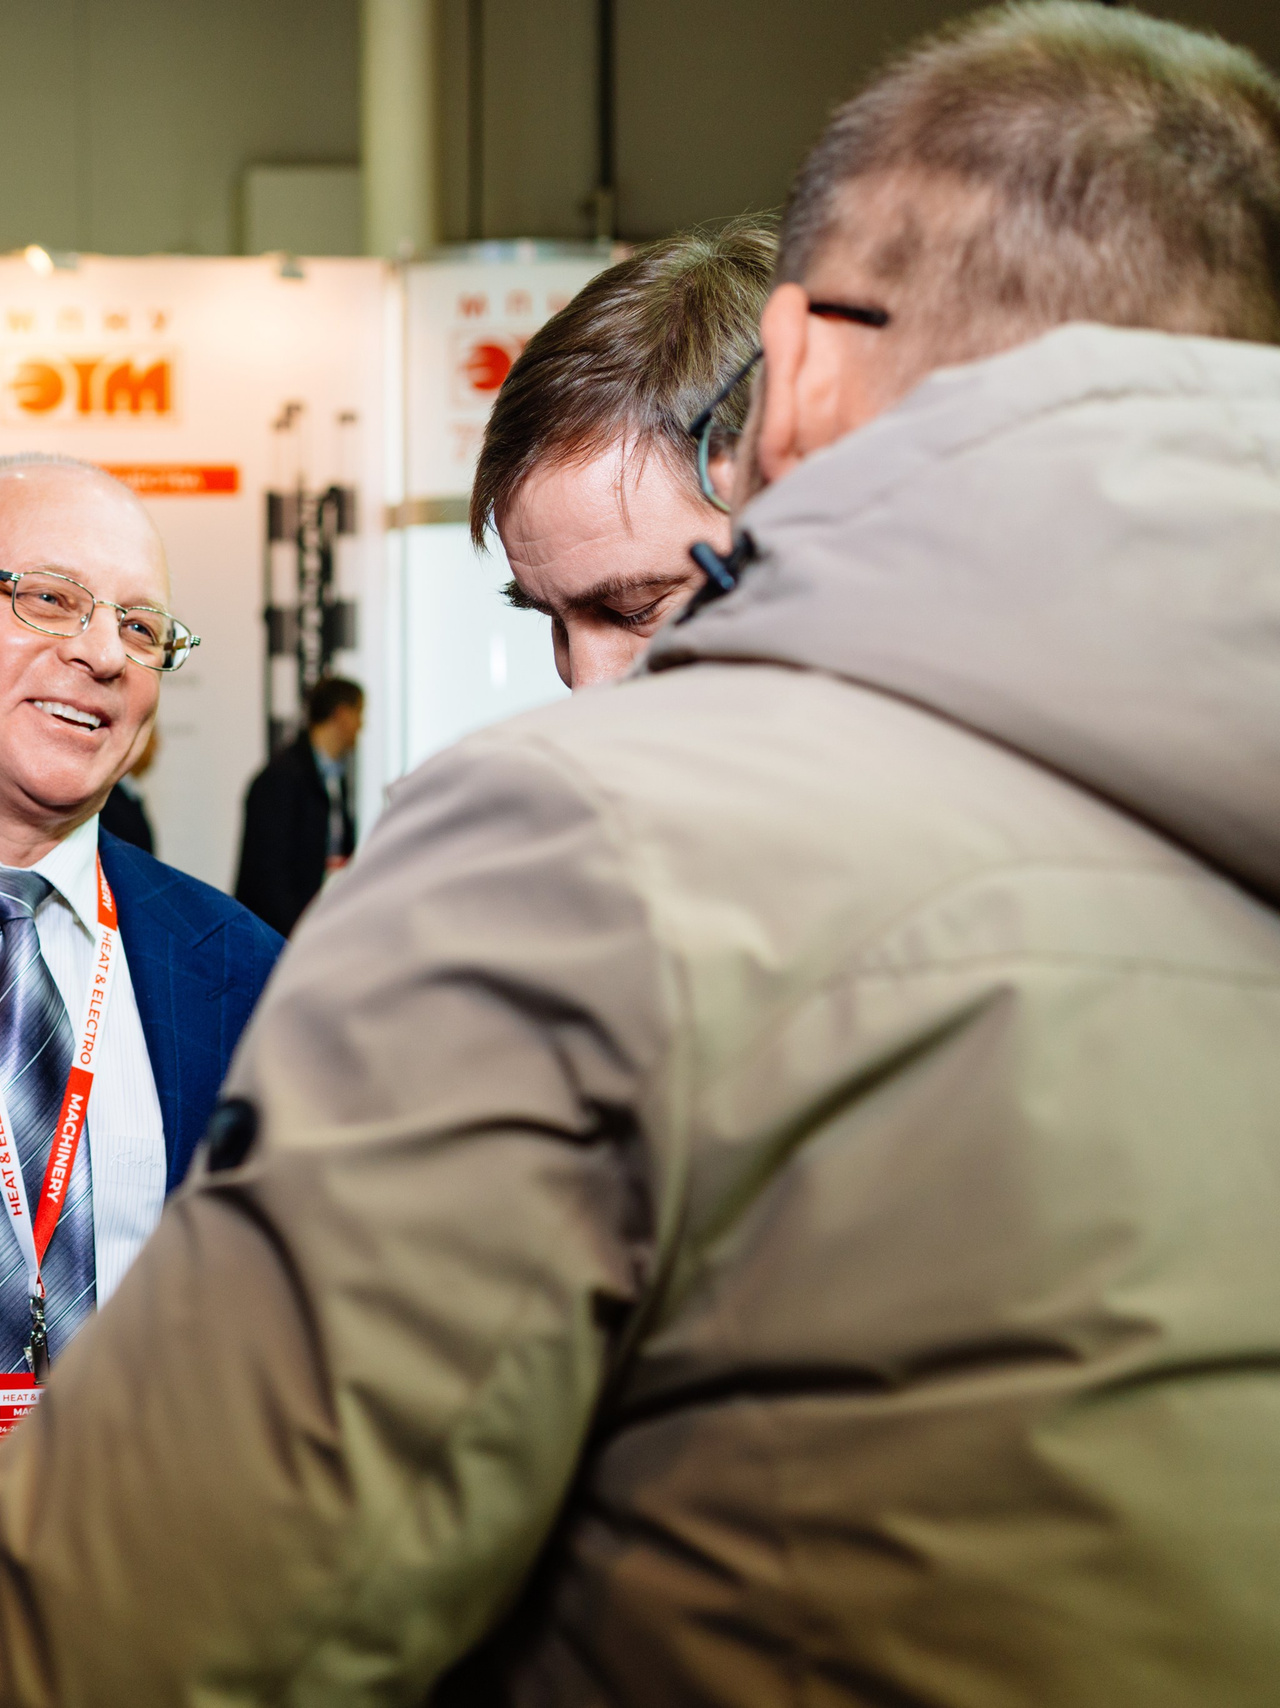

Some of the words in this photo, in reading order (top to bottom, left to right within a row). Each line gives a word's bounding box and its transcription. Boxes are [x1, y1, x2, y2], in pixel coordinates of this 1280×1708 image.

[98, 930, 112, 973] HEAT
[95, 973, 107, 984] &
[80, 988, 104, 1065] ELECTRO
[0, 1152, 12, 1164] &
[47, 1093, 84, 1204] MACHINERY
[1, 1168, 23, 1216] HEAT
[2, 1393, 28, 1402] HEAT
[30, 1393, 37, 1401] &
